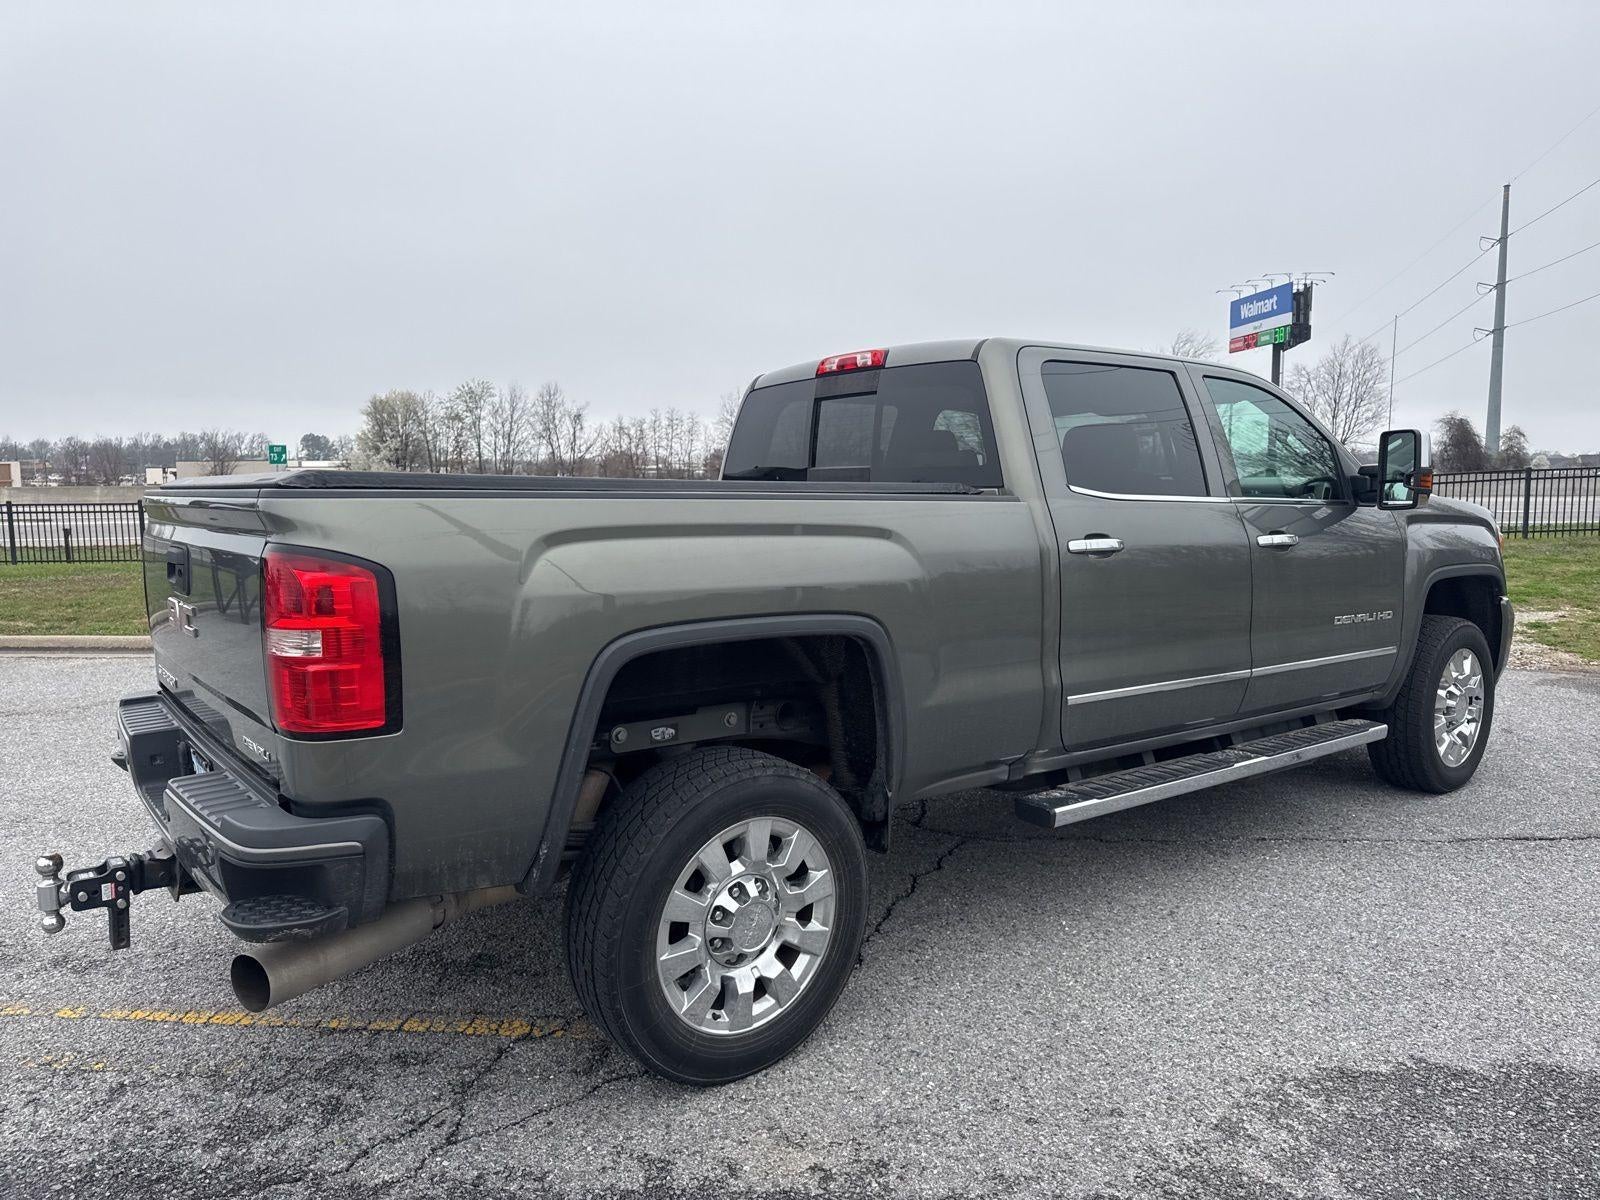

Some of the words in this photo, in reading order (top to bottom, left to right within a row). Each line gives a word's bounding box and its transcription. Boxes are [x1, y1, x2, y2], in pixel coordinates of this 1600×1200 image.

[1240, 294, 1278, 320] Walmart
[1334, 612, 1377, 625] DENALI
[1377, 610, 1393, 620] HD
